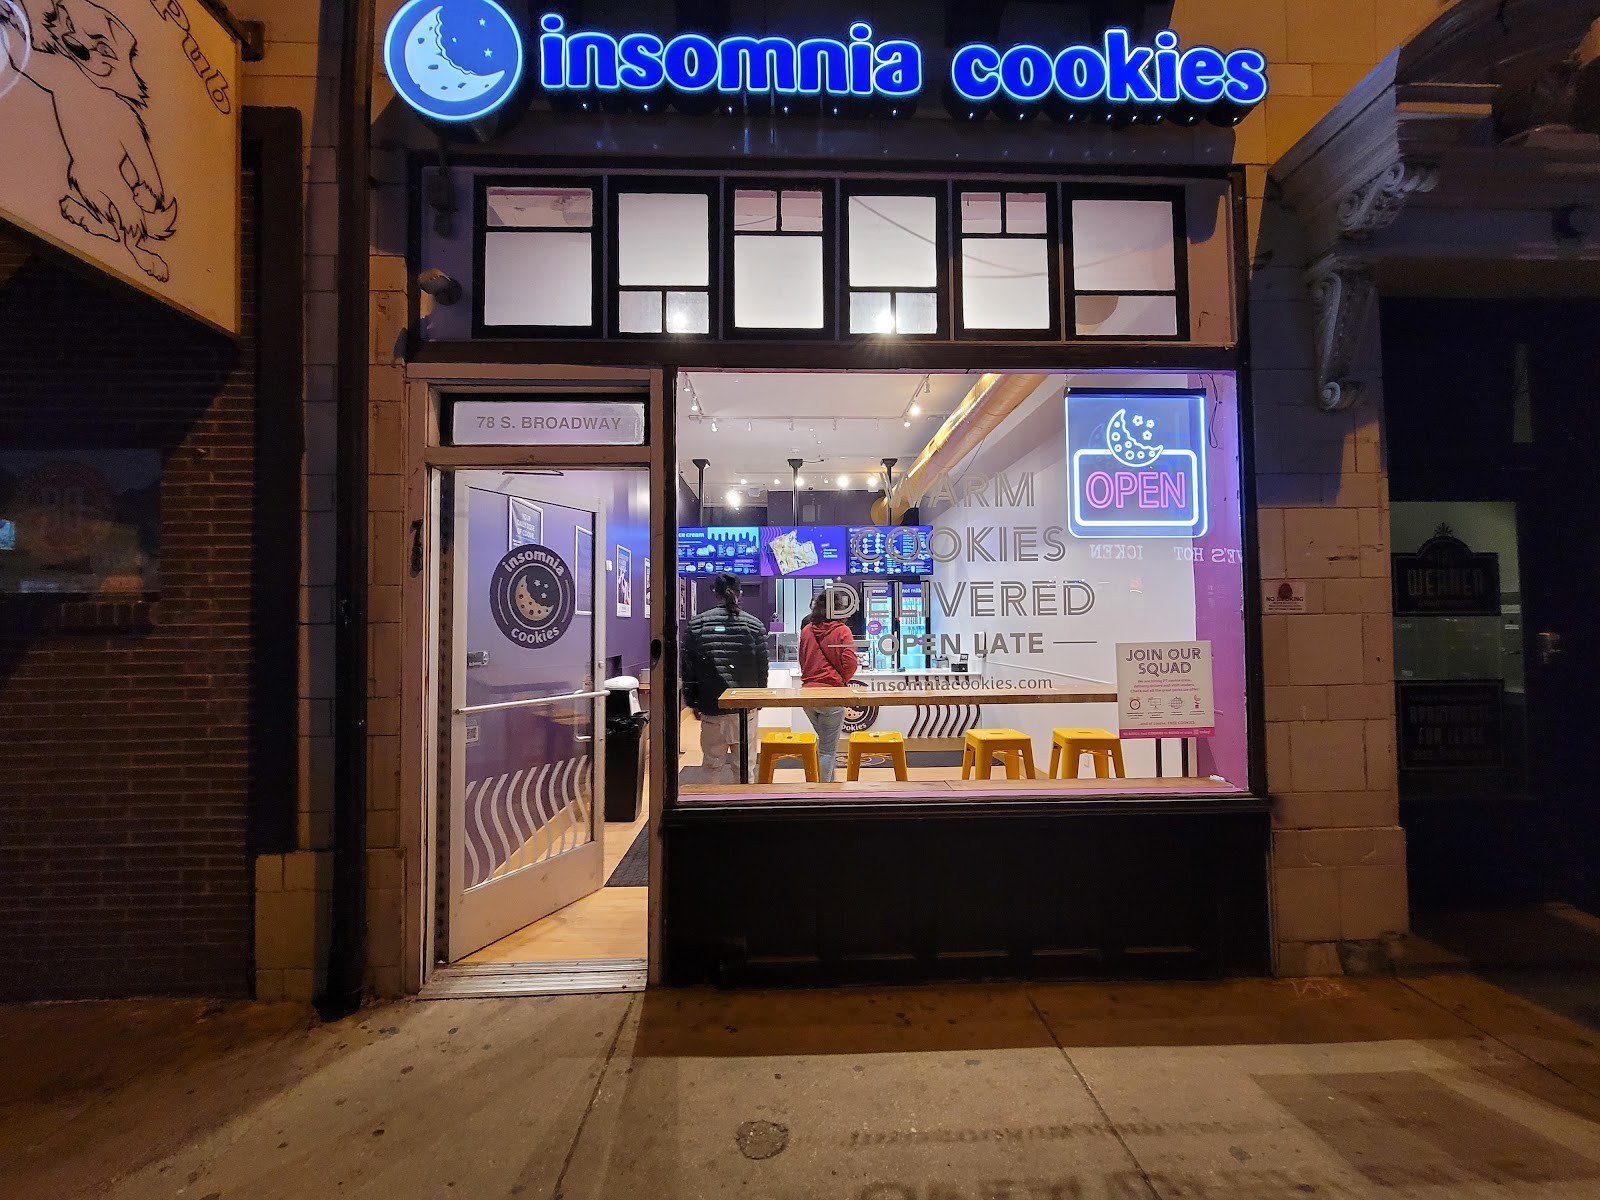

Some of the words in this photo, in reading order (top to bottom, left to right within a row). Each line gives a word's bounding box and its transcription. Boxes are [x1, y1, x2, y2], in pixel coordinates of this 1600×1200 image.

[150, 0, 231, 115] Pub
[540, 13, 922, 96] insomnia
[951, 28, 1267, 103] cookies
[477, 416, 495, 429] 78
[500, 416, 515, 429] S.
[521, 416, 621, 430] BROADWAY
[879, 472, 1035, 508] WARM
[1085, 471, 1186, 509] OPEN
[852, 525, 1066, 563] COOKIES
[502, 550, 565, 577] insomnia
[825, 579, 1096, 620] DELIVERED
[511, 626, 560, 644] cookies
[878, 633, 961, 655] OPEN
[974, 632, 1044, 655] LATE
[1126, 648, 1162, 661] JOIN
[1168, 647, 1201, 660] OUR
[1138, 661, 1192, 677] SQUAD
[871, 677, 1053, 692] insomniacookies.com
[841, 723, 867, 731] ookies
